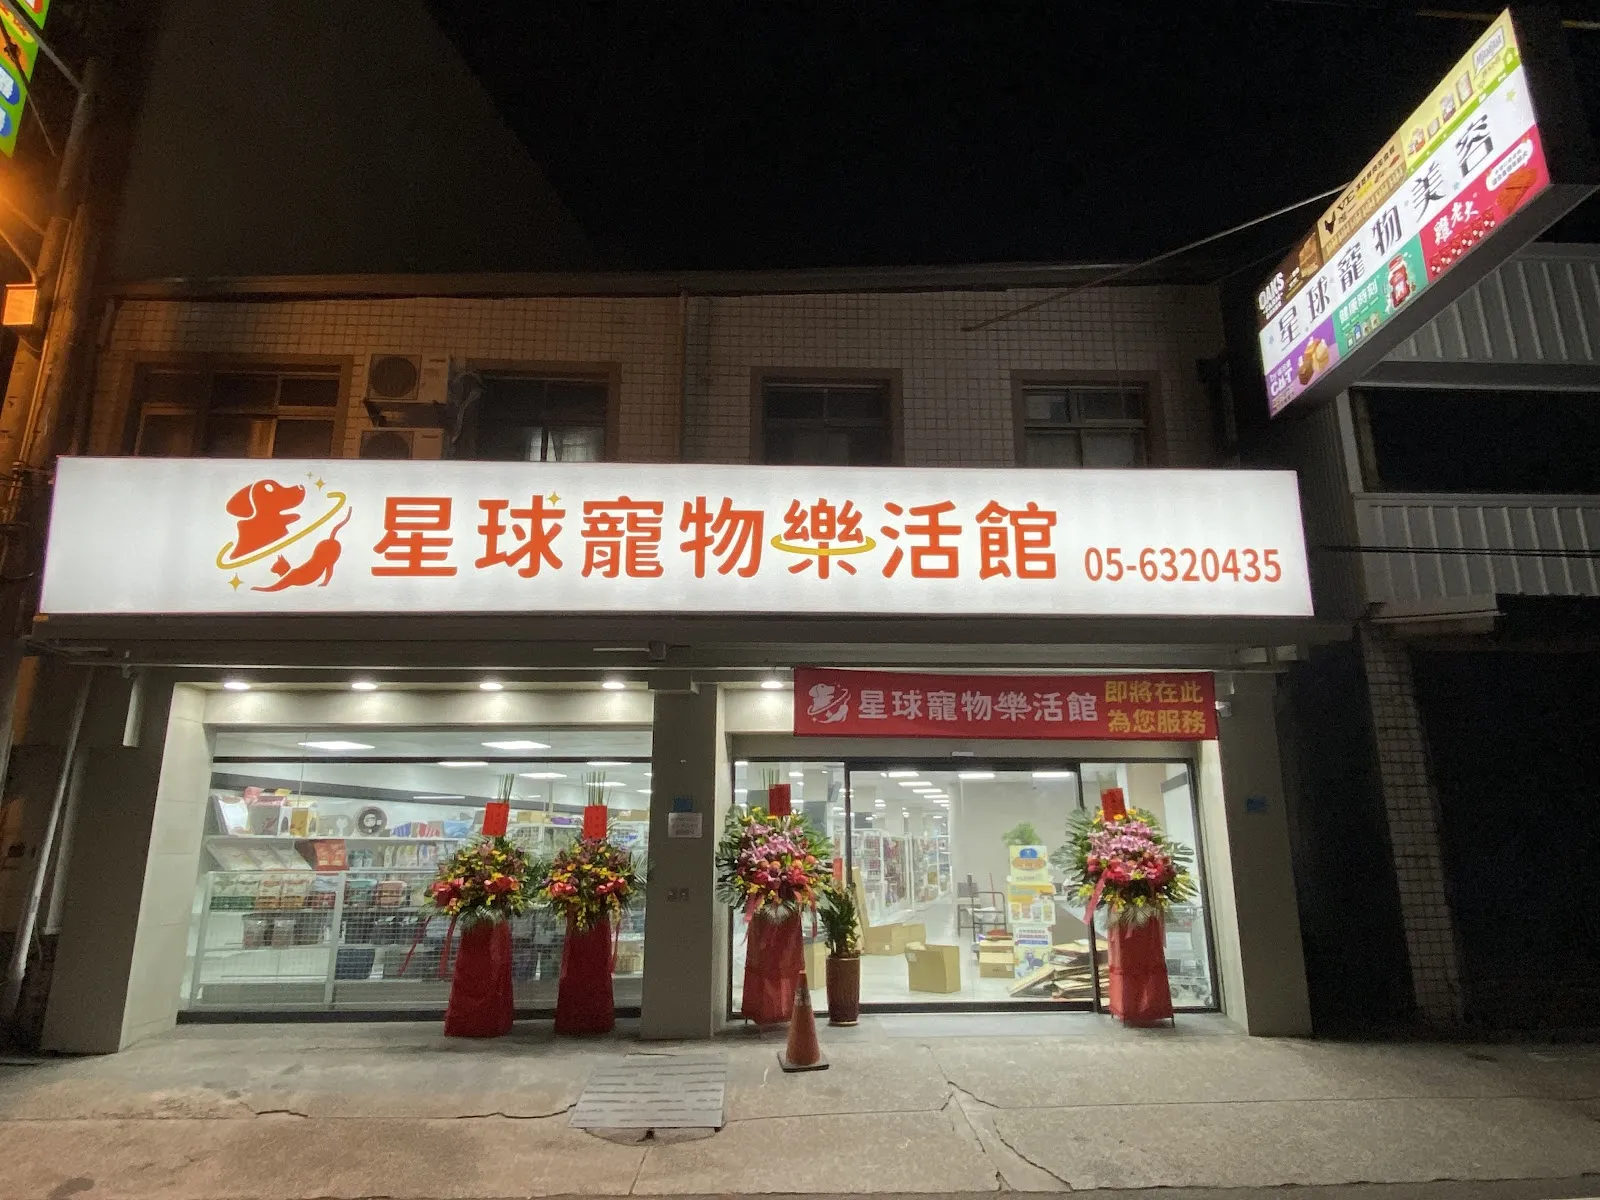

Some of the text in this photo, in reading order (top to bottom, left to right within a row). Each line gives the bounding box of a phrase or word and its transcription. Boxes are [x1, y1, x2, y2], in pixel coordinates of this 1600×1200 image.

[1278, 114, 1494, 352] 星球寵物美容
[1258, 271, 1285, 310] OAKS
[1339, 278, 1378, 324] 健康時刻
[370, 496, 1057, 580] 星球寵物樂活館
[1084, 546, 1282, 583] 05-6320435
[857, 689, 1098, 722] 星球寵物樂活館
[1105, 680, 1204, 703] 即將在此
[1107, 709, 1206, 733] 為您服務
